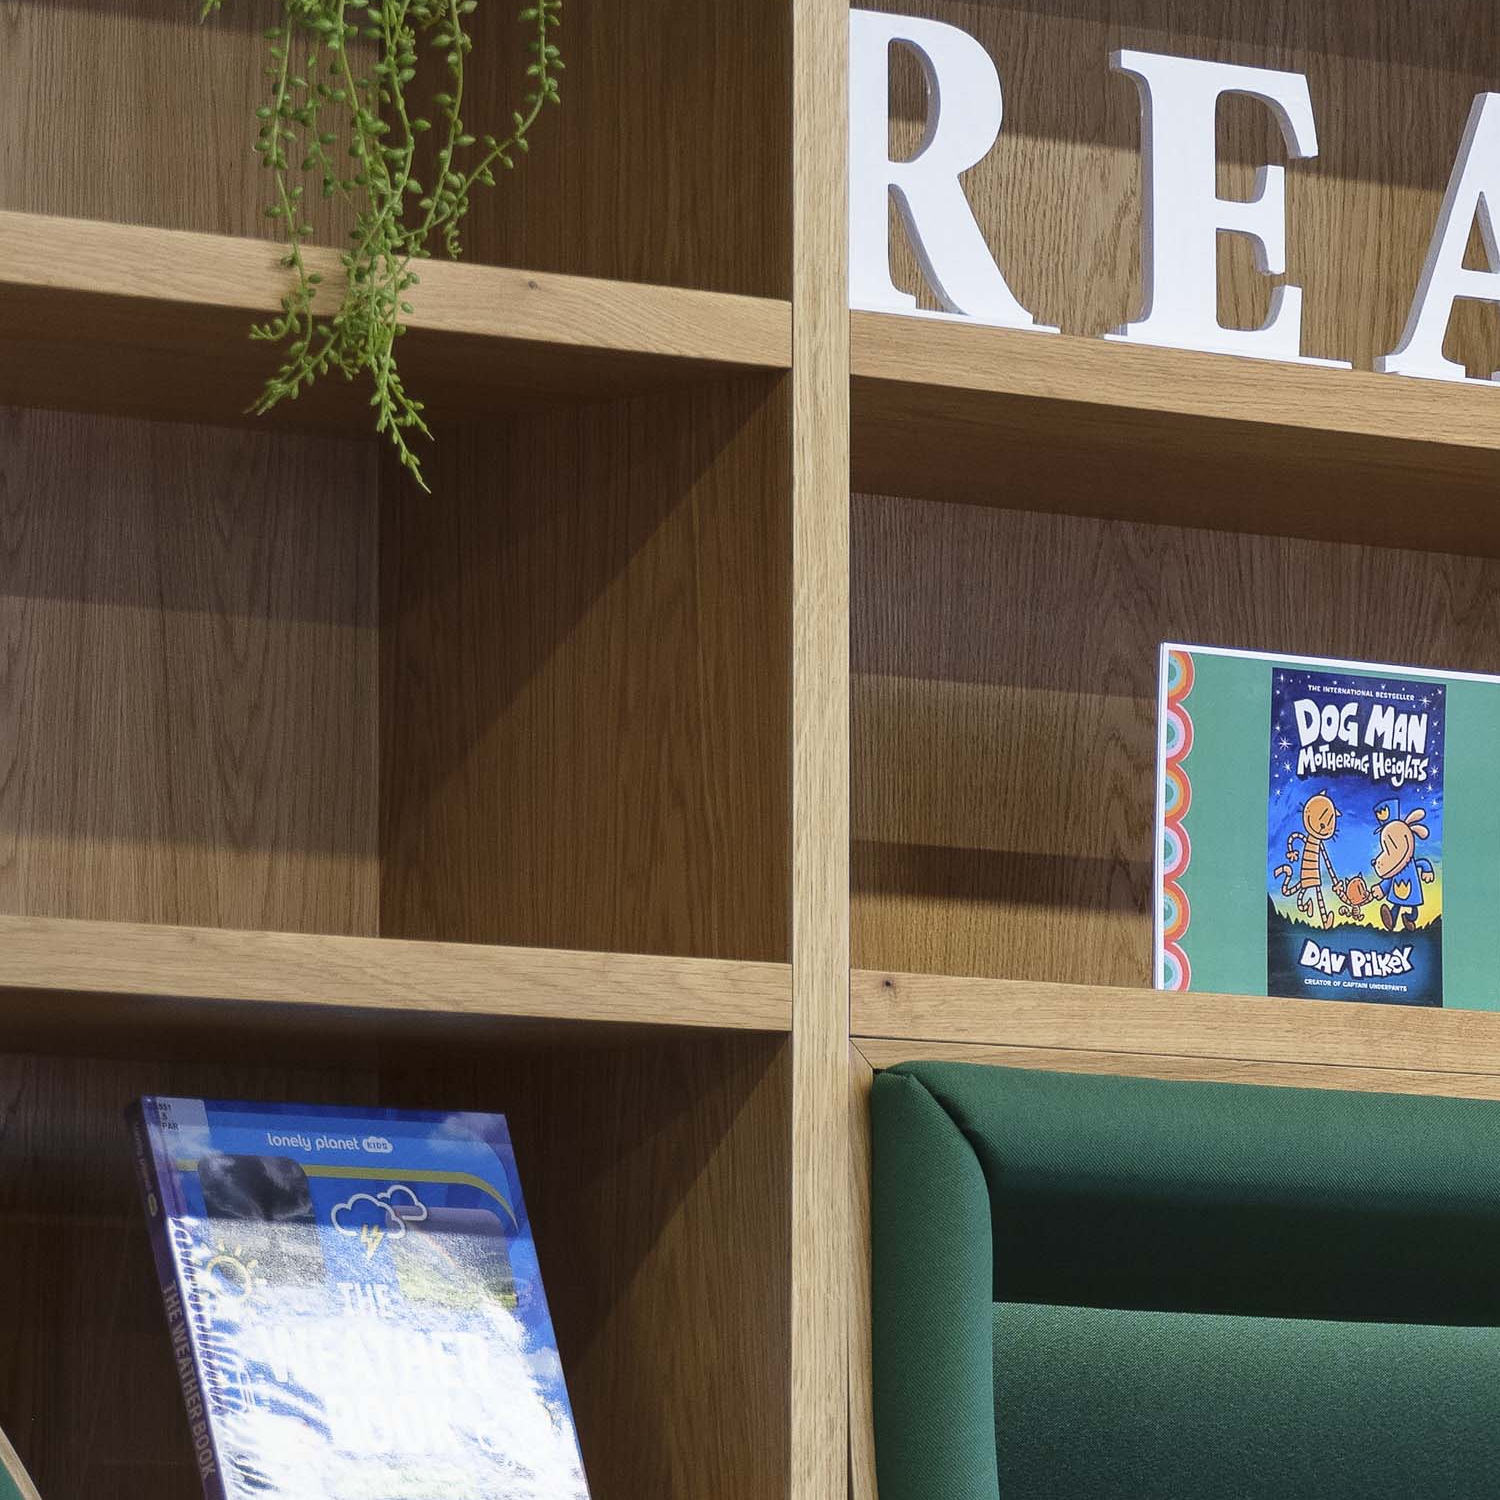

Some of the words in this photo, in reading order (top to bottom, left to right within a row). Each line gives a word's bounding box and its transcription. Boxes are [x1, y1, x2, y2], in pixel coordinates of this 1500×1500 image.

[1307, 684, 1321, 692] THE
[1322, 685, 1374, 698] INTERNATIONAL
[1375, 691, 1415, 701] BESTSELLER
[1294, 698, 1359, 747] DOG
[1364, 704, 1428, 754] MAN
[1300, 940, 1346, 975] DAV
[1304, 978, 1332, 987] CREATOR
[1342, 981, 1368, 989] CAPTAIN
[1369, 983, 1408, 992] UNDERPANTS
[266, 1132, 312, 1152] lonely
[315, 1135, 360, 1151] planet
[162, 1281, 184, 1324] THE
[171, 1323, 204, 1420] WEATHER
[191, 1418, 217, 1479] BOOK
